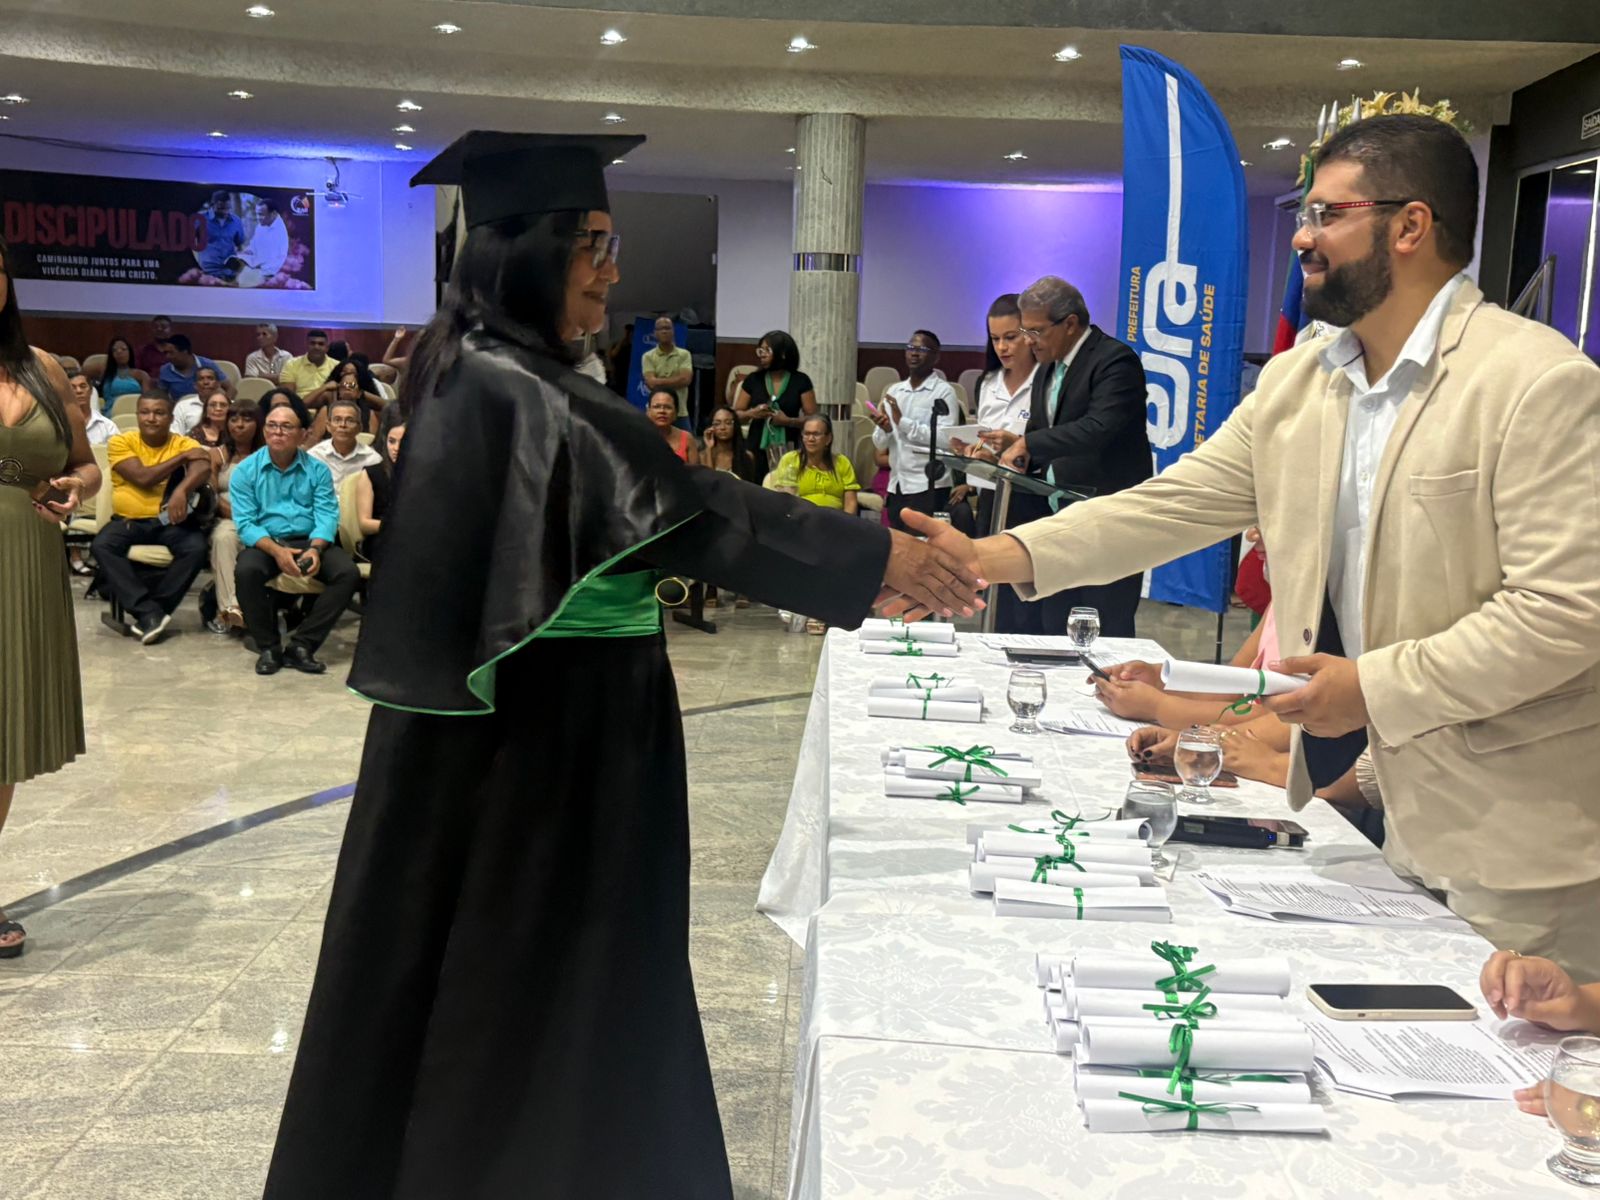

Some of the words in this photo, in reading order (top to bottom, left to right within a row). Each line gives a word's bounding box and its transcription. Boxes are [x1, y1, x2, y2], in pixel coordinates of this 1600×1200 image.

[4, 201, 208, 252] DISCIPULADO
[36, 254, 89, 265] CAMINHANDO
[91, 256, 119, 266] JUNTOS
[121, 258, 141, 267] PARA
[143, 259, 160, 268] UMA
[81, 266, 108, 277] DIÁRIA
[110, 269, 127, 278] COM
[128, 270, 158, 279] CRISTO.
[1127, 266, 1141, 343] PREFEITURA
[1199, 283, 1216, 348] SAÚDE
[1199, 350, 1210, 375] DE
[1017, 409, 1031, 420] Fe
